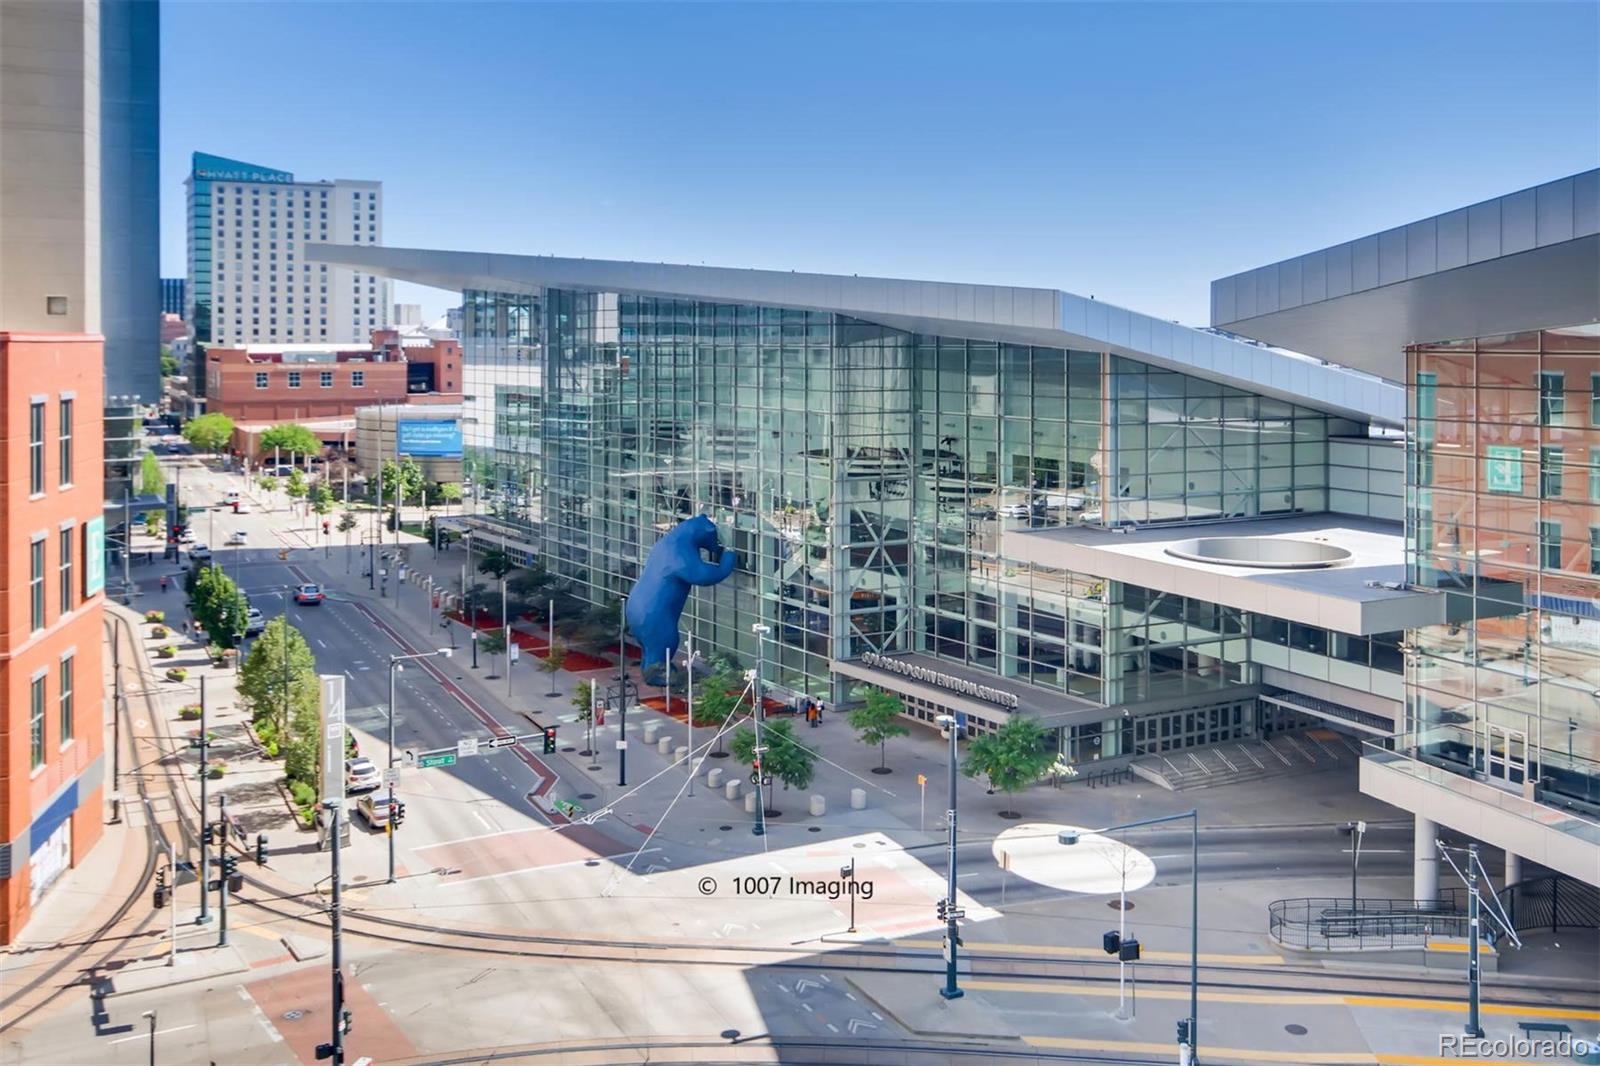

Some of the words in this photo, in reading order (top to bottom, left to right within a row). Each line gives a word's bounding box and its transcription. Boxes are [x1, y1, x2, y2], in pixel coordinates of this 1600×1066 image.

[207, 170, 248, 179] HYATT
[252, 173, 293, 182] PLACE
[862, 651, 912, 675] COLORADO
[911, 666, 976, 695] CONVENTION
[975, 685, 1018, 708] CENTER
